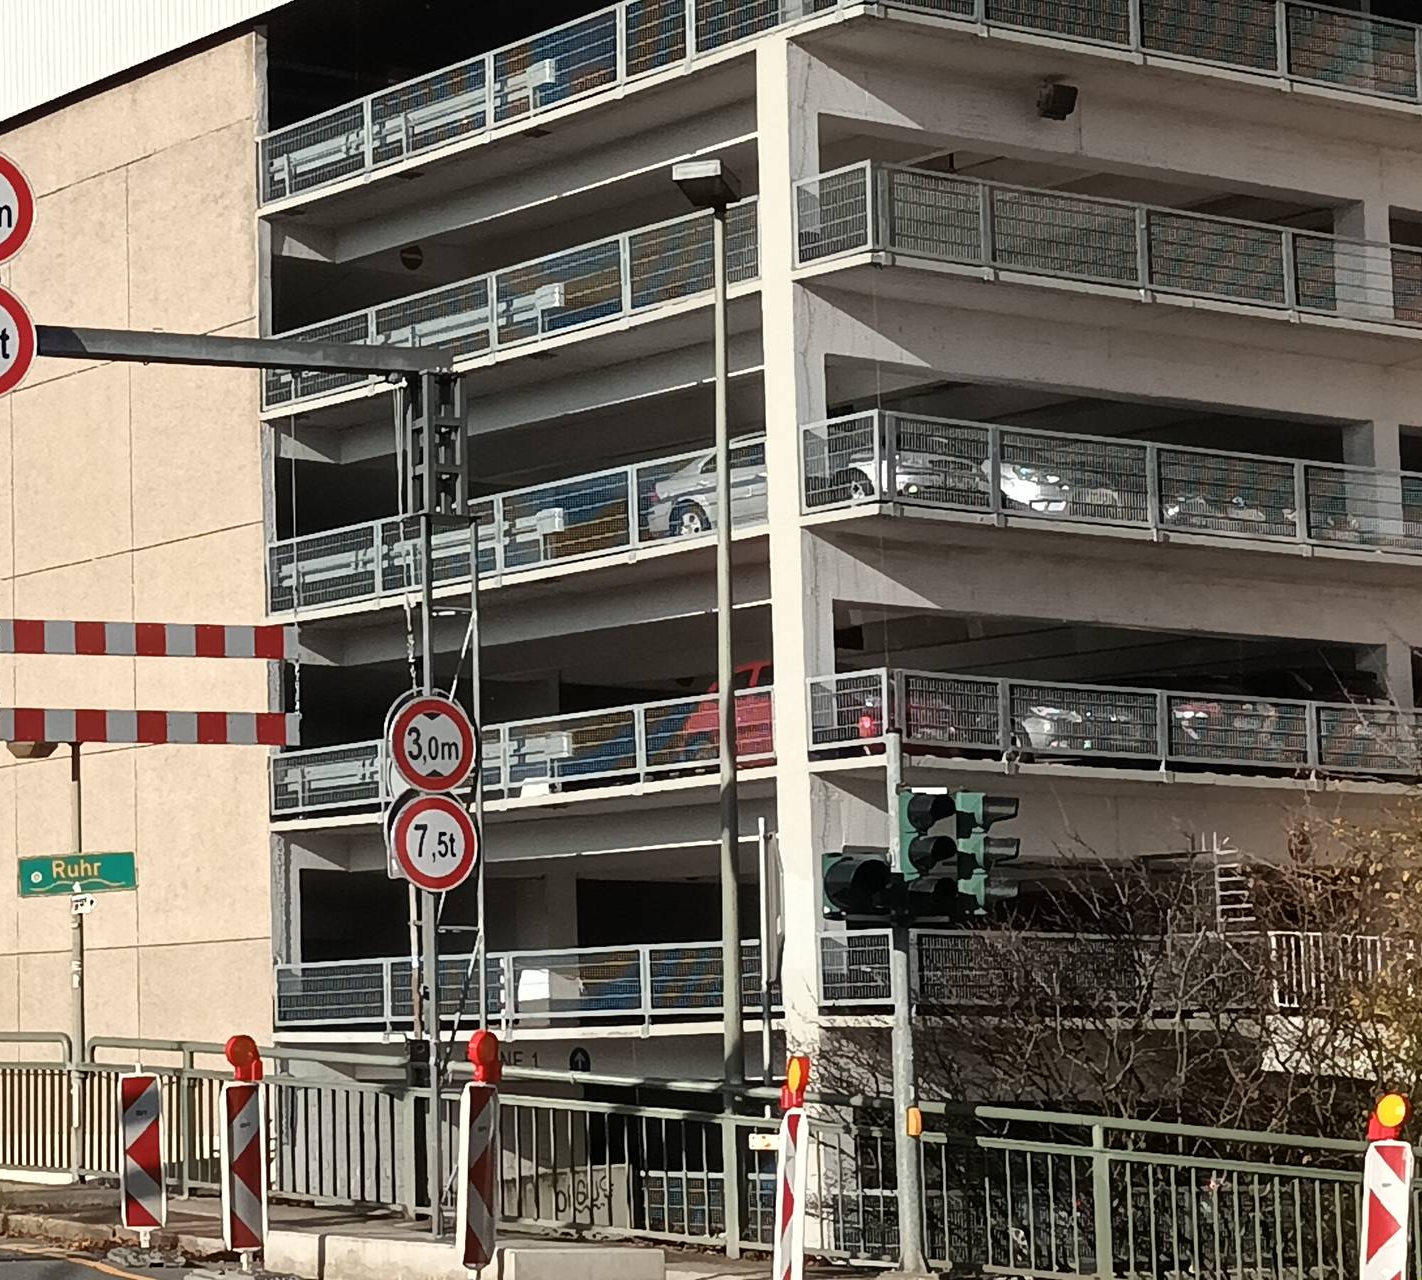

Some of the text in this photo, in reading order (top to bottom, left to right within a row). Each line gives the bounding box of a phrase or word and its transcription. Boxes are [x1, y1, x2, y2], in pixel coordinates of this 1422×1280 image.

[407, 727, 459, 765] 3,0m
[414, 824, 457, 863] 7,5t
[51, 860, 102, 879] Ruhr
